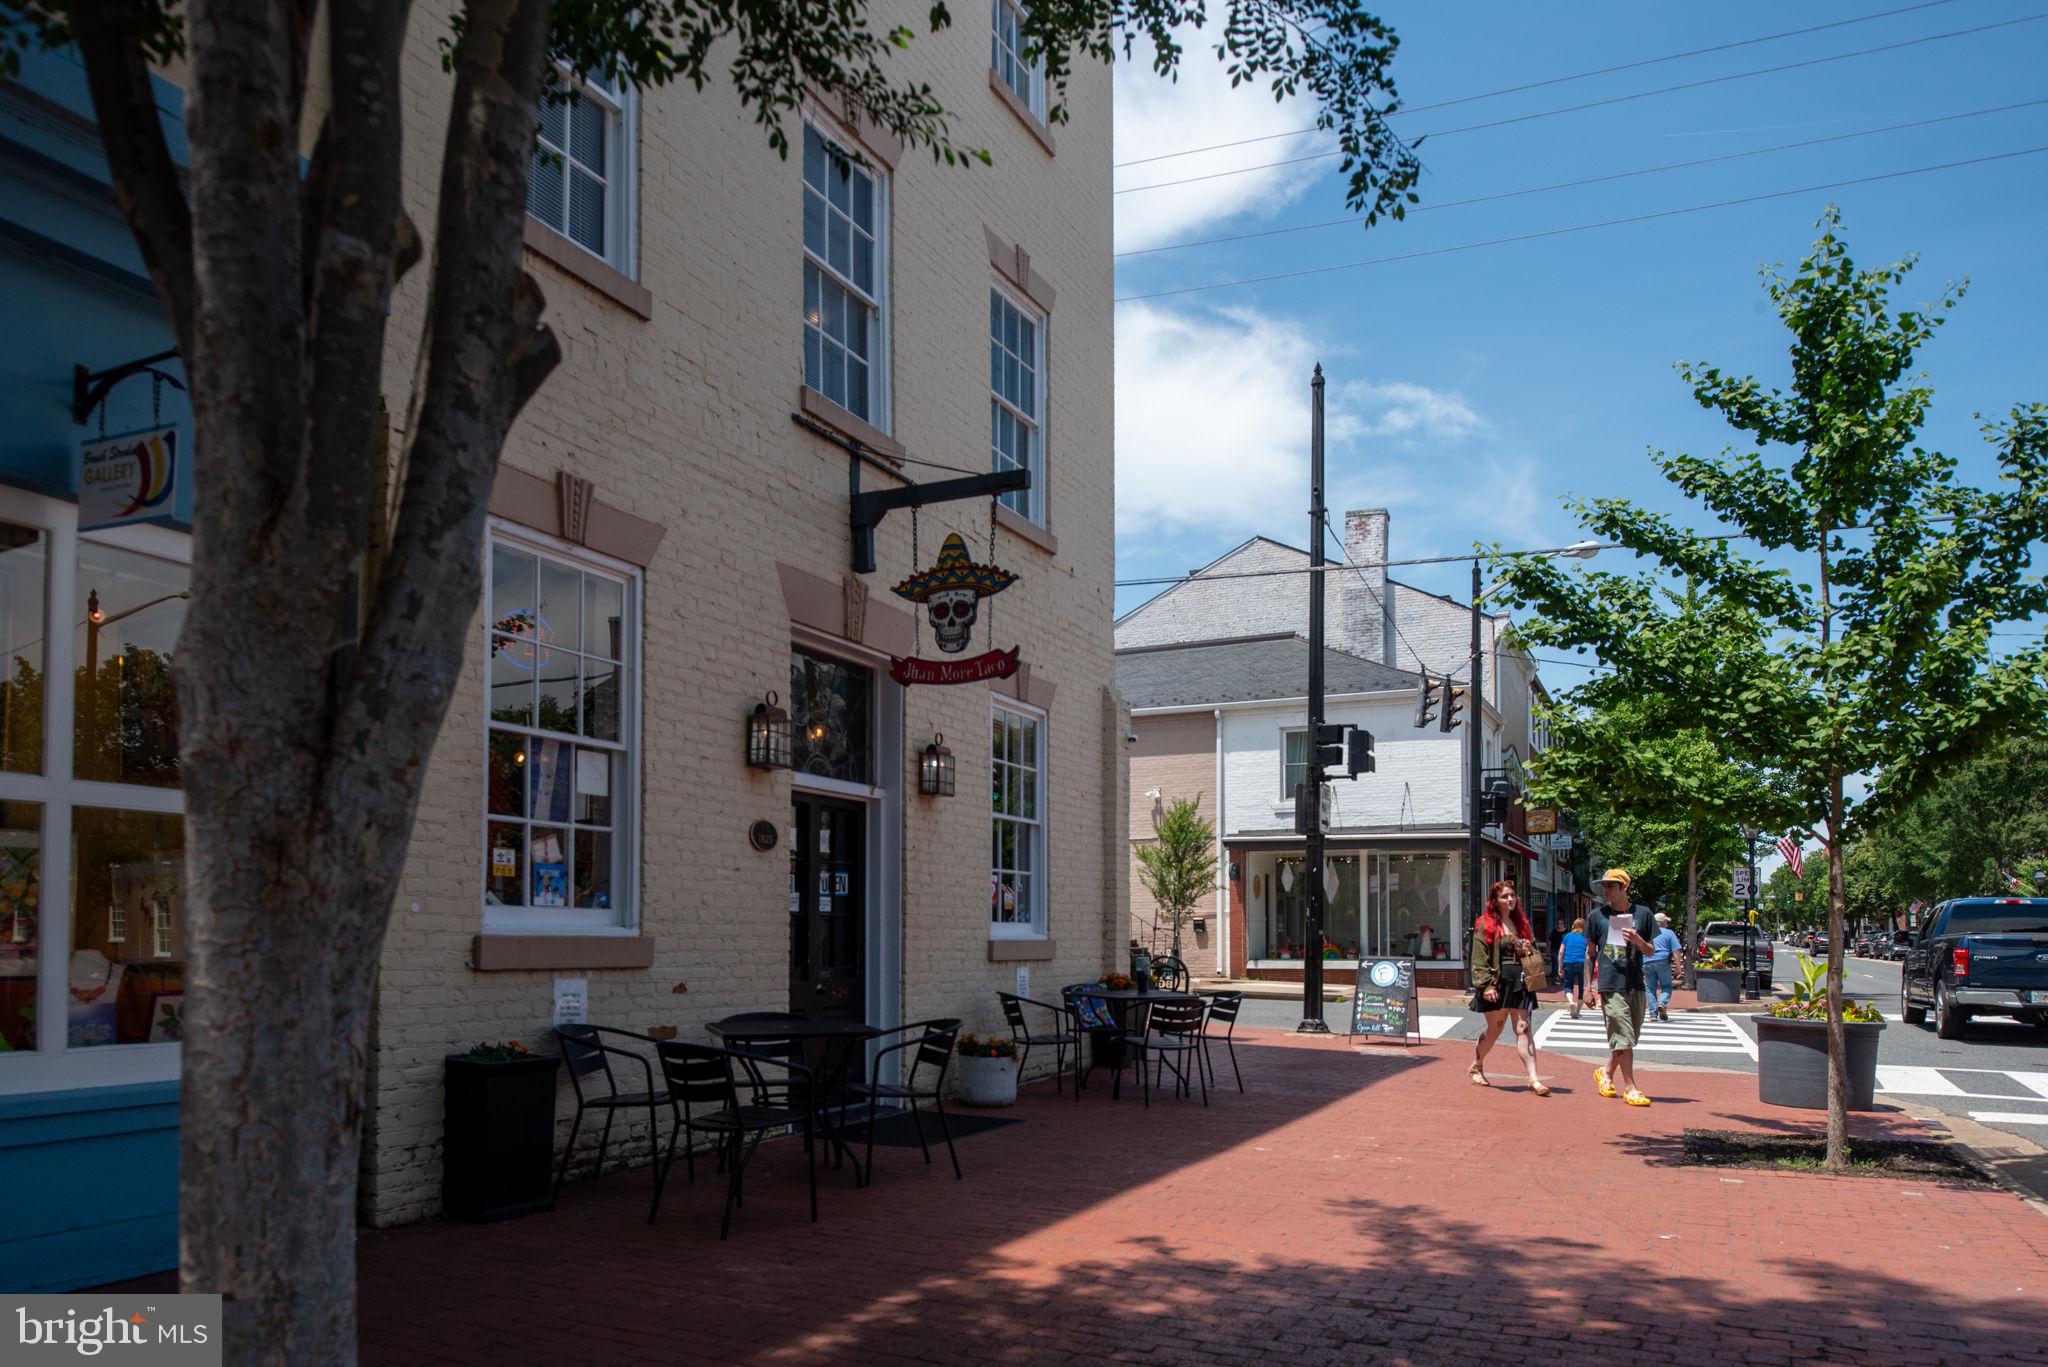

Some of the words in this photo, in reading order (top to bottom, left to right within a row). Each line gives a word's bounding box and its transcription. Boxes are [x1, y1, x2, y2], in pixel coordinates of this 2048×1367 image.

[84, 463, 135, 486] GALLERY
[903, 662, 934, 681] Juan
[975, 659, 1006, 677] Taco
[1735, 884, 1758, 895] 20
[1357, 1024, 1371, 1033] Open
